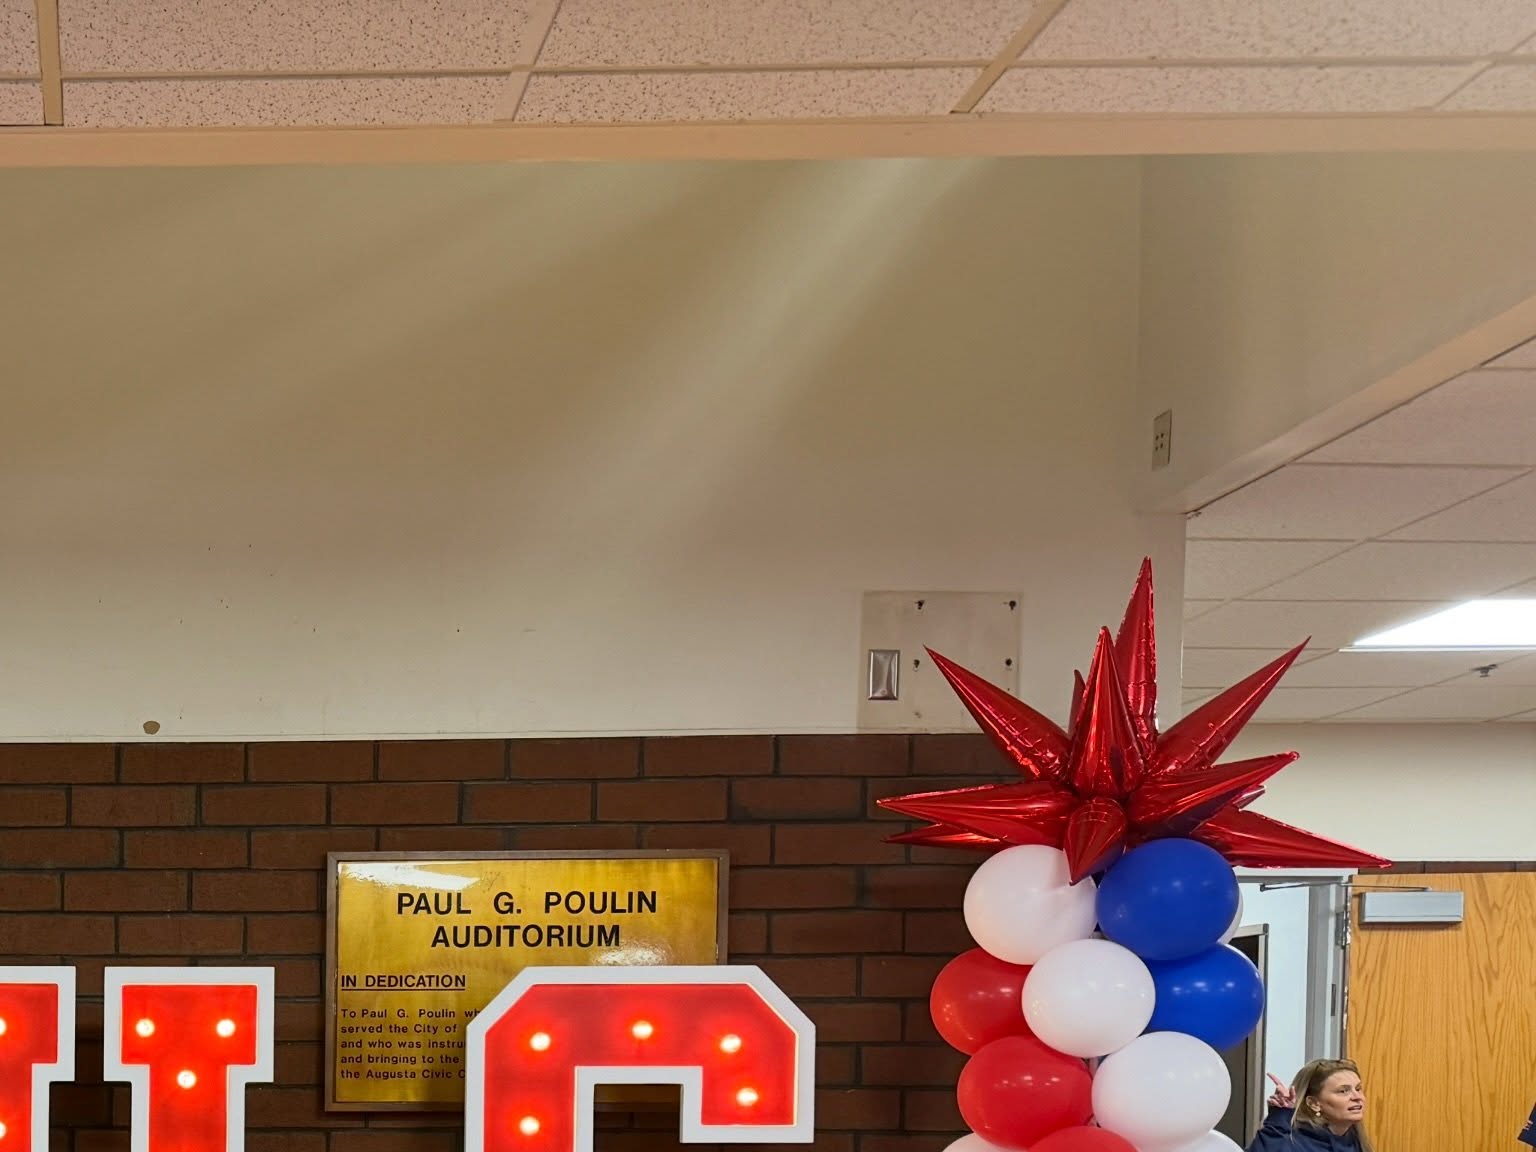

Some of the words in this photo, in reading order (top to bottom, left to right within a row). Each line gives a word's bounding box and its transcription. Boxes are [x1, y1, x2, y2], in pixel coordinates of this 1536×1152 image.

[397, 892, 471, 915] PAUL
[493, 891, 522, 914] G.
[544, 890, 657, 914] POULIN
[431, 924, 620, 948] AUDITORIUM
[341, 975, 357, 988] IN
[365, 974, 466, 988] DEDICATION
[341, 1008, 357, 1019] To
[361, 1008, 387, 1018] Paul
[397, 1008, 409, 1019] G.
[418, 1008, 456, 1018] Poulin
[340, 1023, 383, 1034] served
[389, 1023, 408, 1034] the
[413, 1023, 439, 1035] City
[444, 1023, 457, 1034] of
[340, 1039, 363, 1049] and
[367, 1039, 393, 1049] who
[397, 1041, 422, 1049] was
[340, 1054, 363, 1064] and
[367, 1053, 417, 1065] bringing
[422, 1054, 435, 1064] to
[440, 1054, 460, 1064] the
[340, 1069, 360, 1079] the
[366, 1069, 416, 1080] Augusta
[421, 1069, 452, 1079] Civic
